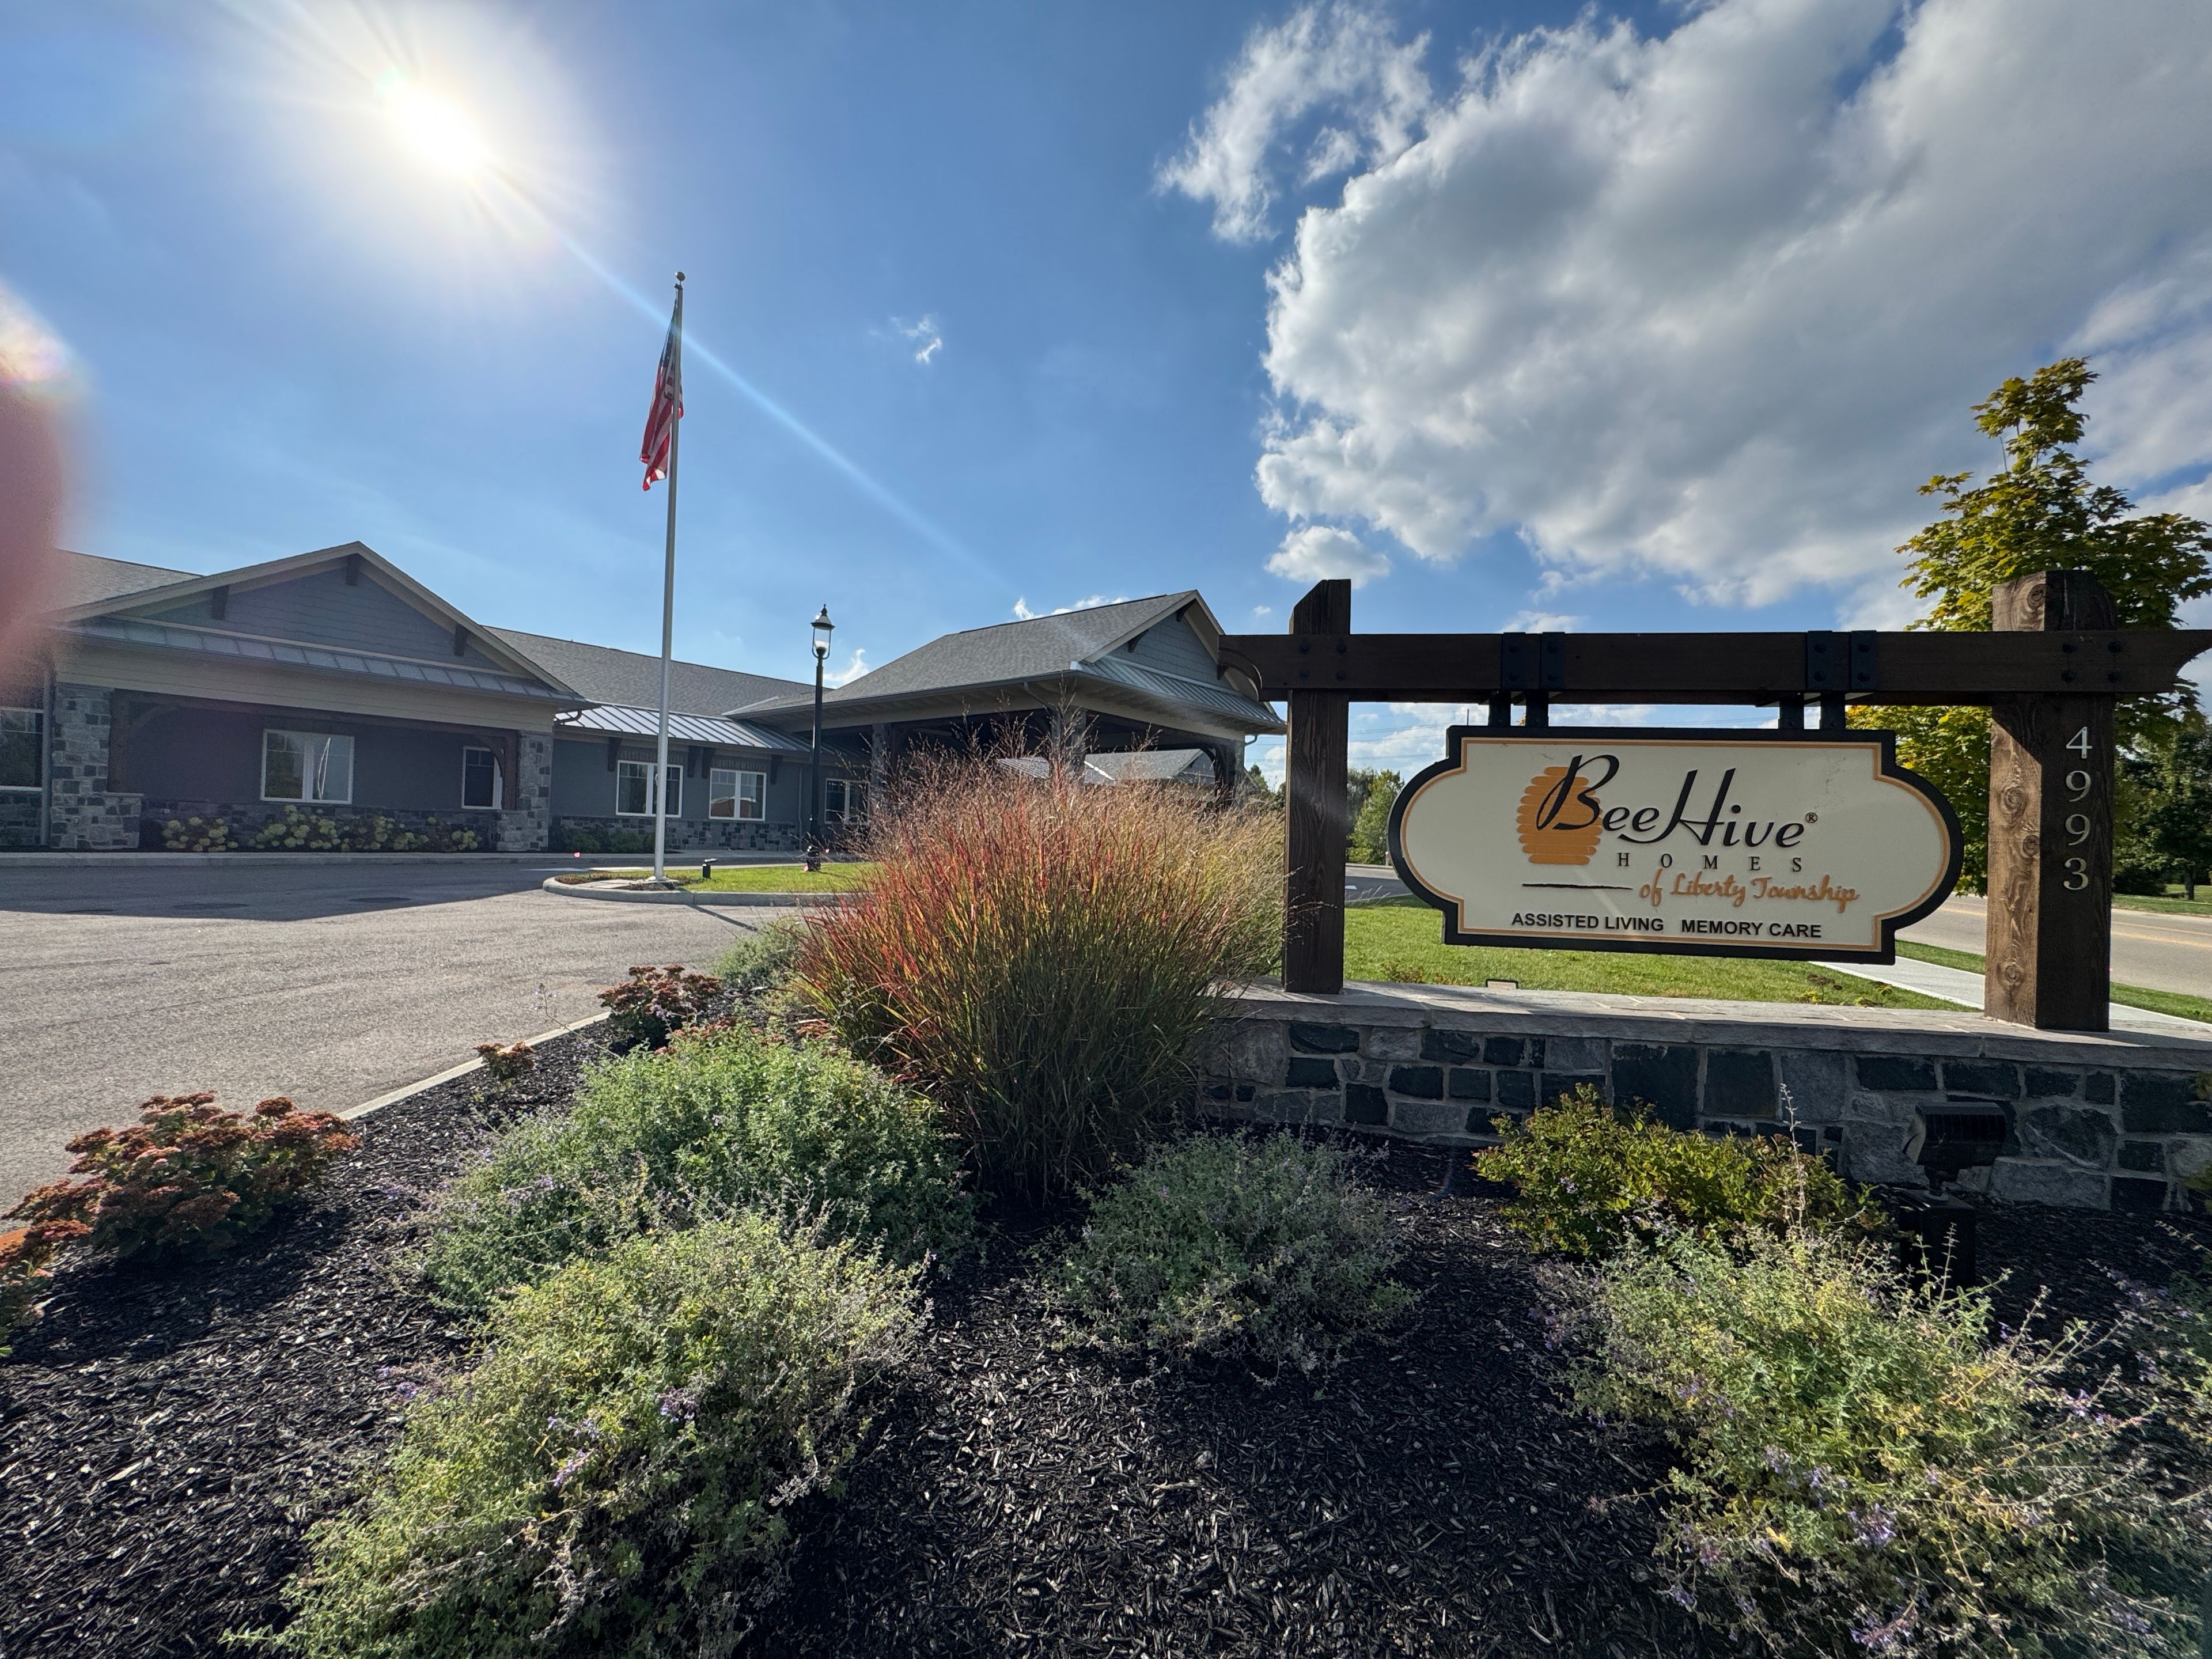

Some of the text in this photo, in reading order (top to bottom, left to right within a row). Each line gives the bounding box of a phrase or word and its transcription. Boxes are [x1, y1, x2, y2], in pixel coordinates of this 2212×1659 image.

[2063, 726, 2093, 891] 4993
[1617, 852, 1802, 872] HOMES
[1639, 868, 1861, 914] of Liberty Township
[1511, 912, 1823, 938] ASSISTED LIVING MEMORY CARE
